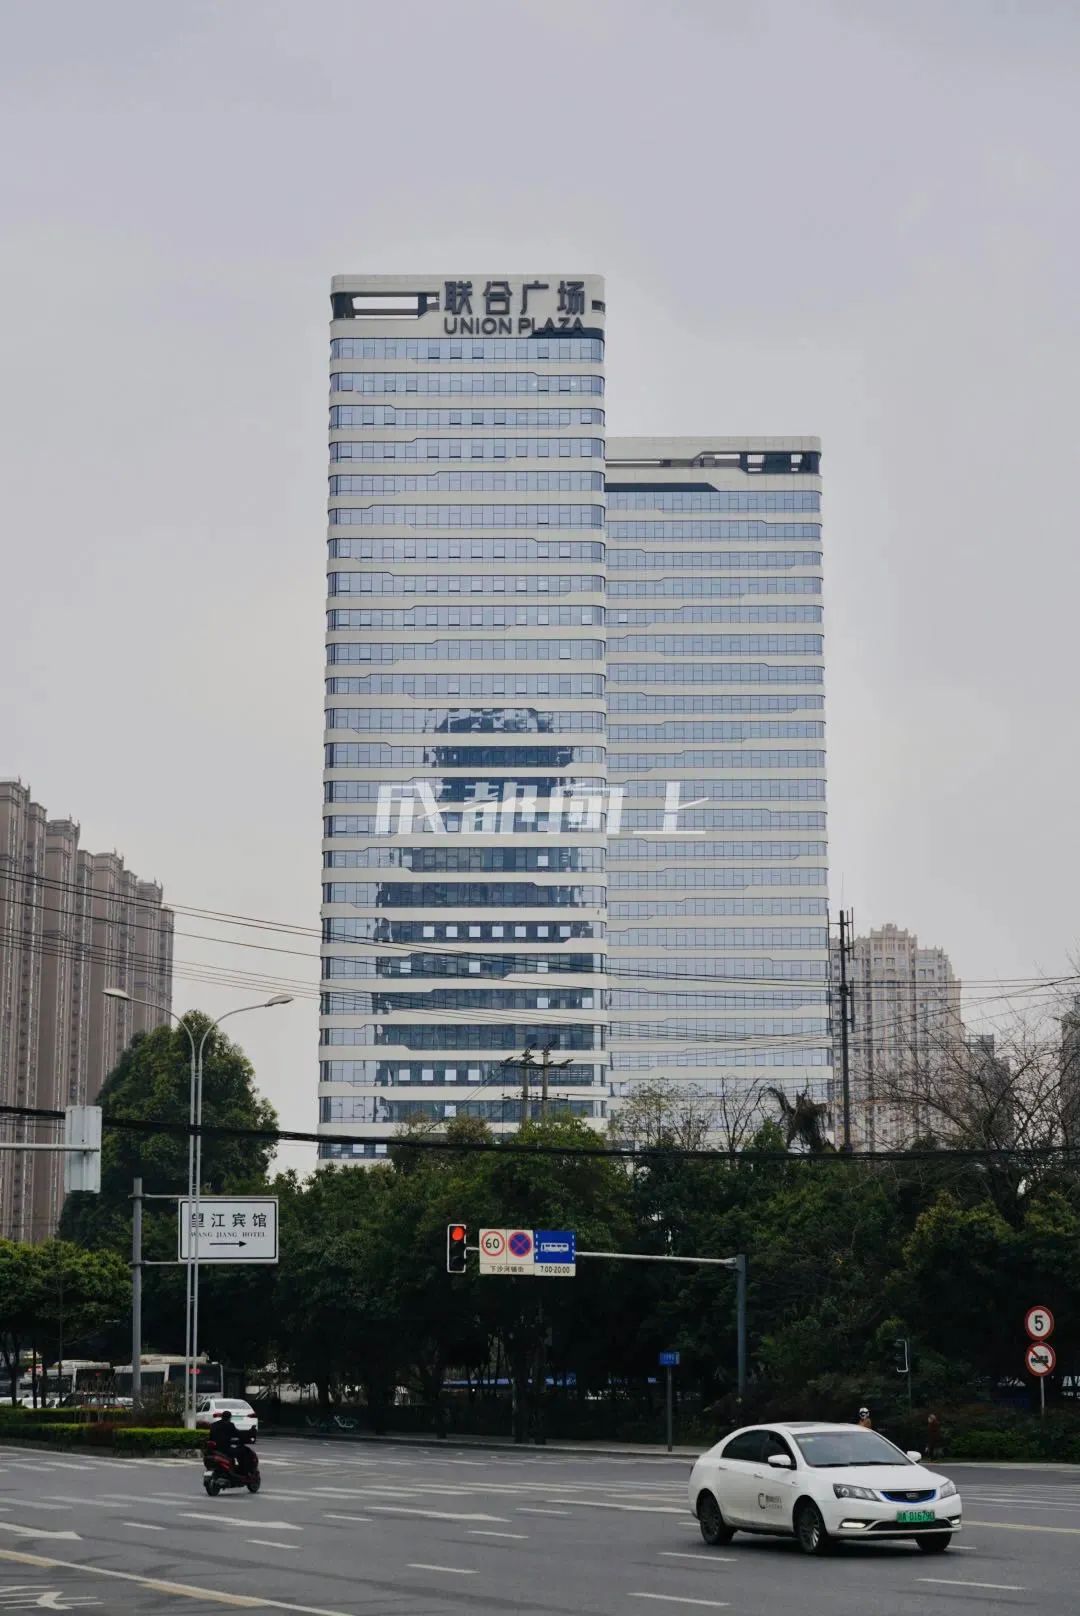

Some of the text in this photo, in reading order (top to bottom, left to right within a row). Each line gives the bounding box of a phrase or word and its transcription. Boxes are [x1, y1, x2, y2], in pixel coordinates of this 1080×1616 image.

[444, 280, 585, 315] 联合广场
[444, 317, 584, 335] UNION PLAZA
[190, 1212, 267, 1228] 望江宾馆
[485, 1238, 500, 1249] 60
[1034, 1314, 1044, 1332] 5
